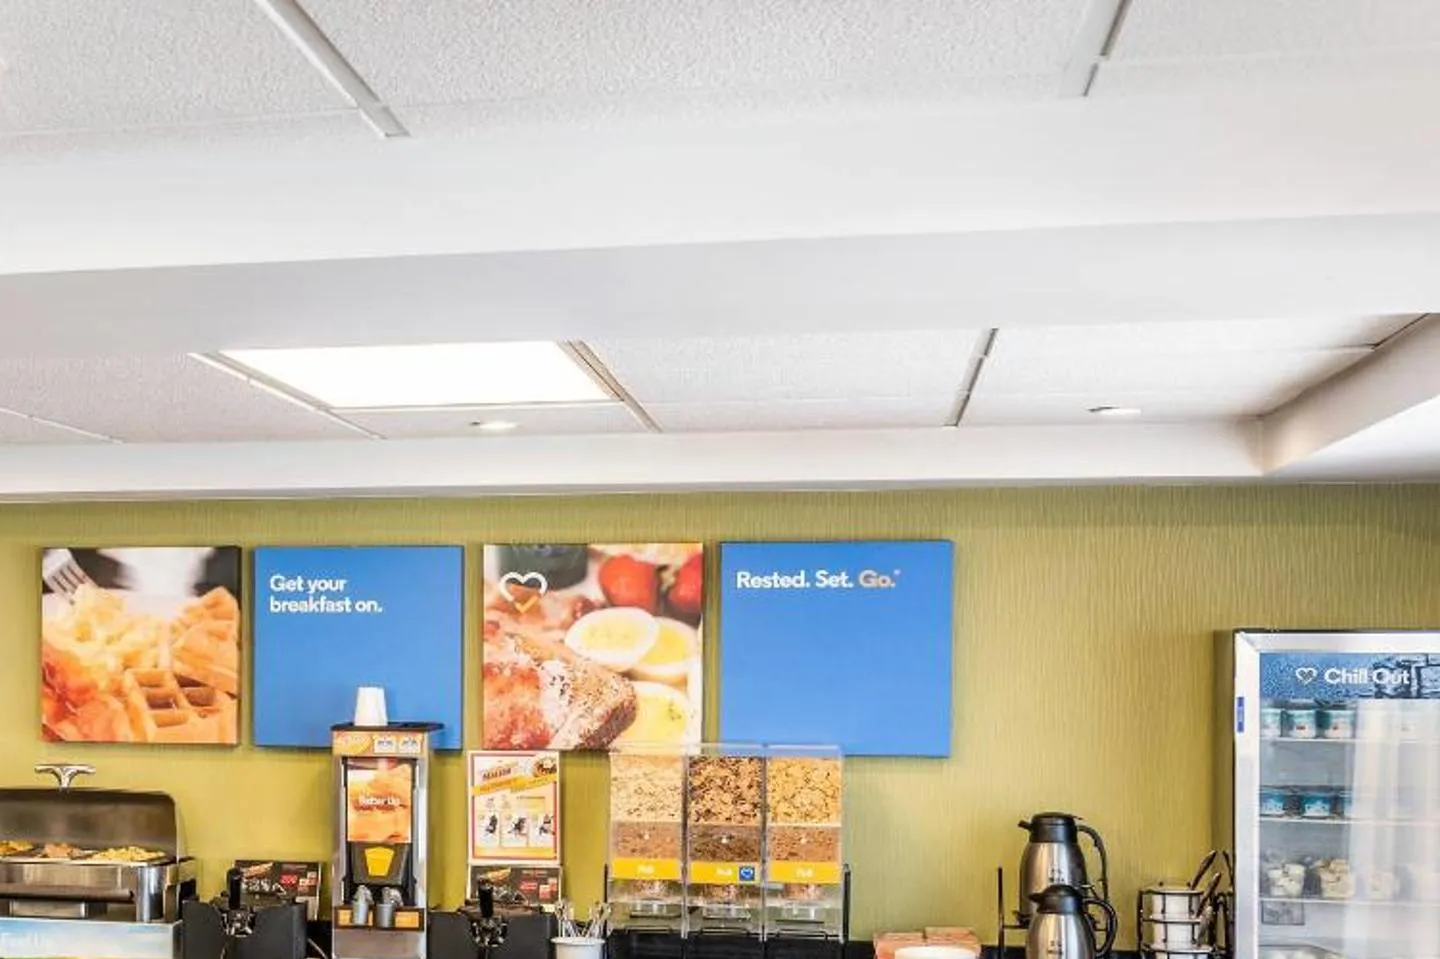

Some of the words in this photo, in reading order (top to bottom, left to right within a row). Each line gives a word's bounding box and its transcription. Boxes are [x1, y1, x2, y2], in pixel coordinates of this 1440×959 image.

[269, 574, 304, 592] Get
[306, 579, 347, 595] your
[736, 570, 810, 589] Rested.
[815, 569, 854, 589] Set.
[269, 595, 352, 613] breakfast
[354, 600, 383, 613] on.
[1324, 667, 1368, 684] Chill
[1372, 667, 1410, 684] Out
